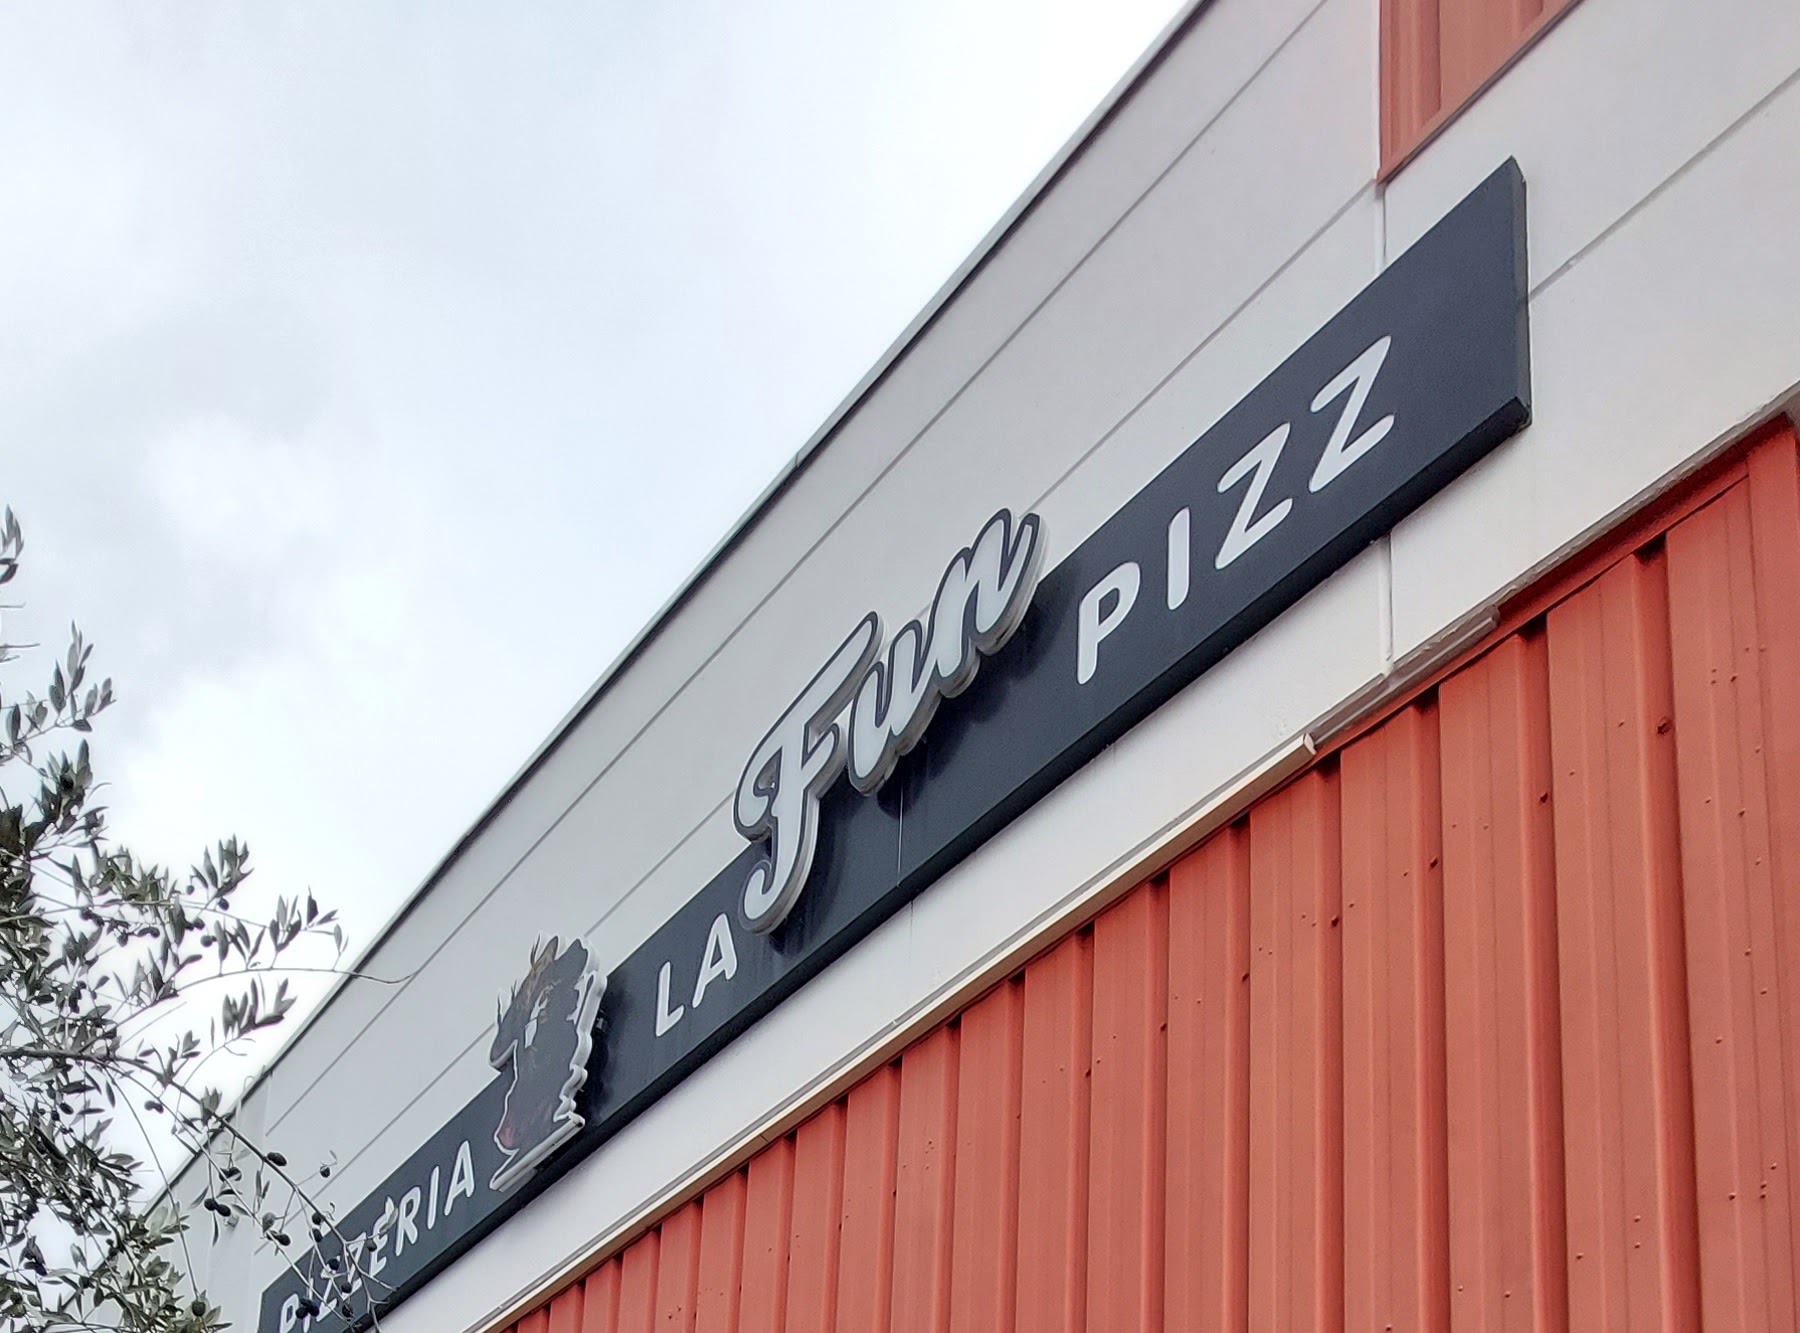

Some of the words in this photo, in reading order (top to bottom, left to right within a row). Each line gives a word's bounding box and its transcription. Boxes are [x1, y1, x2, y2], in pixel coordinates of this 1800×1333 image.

[655, 913, 738, 1038] LA
[733, 507, 1049, 935] Fun
[1076, 335, 1395, 684] PIZZ
